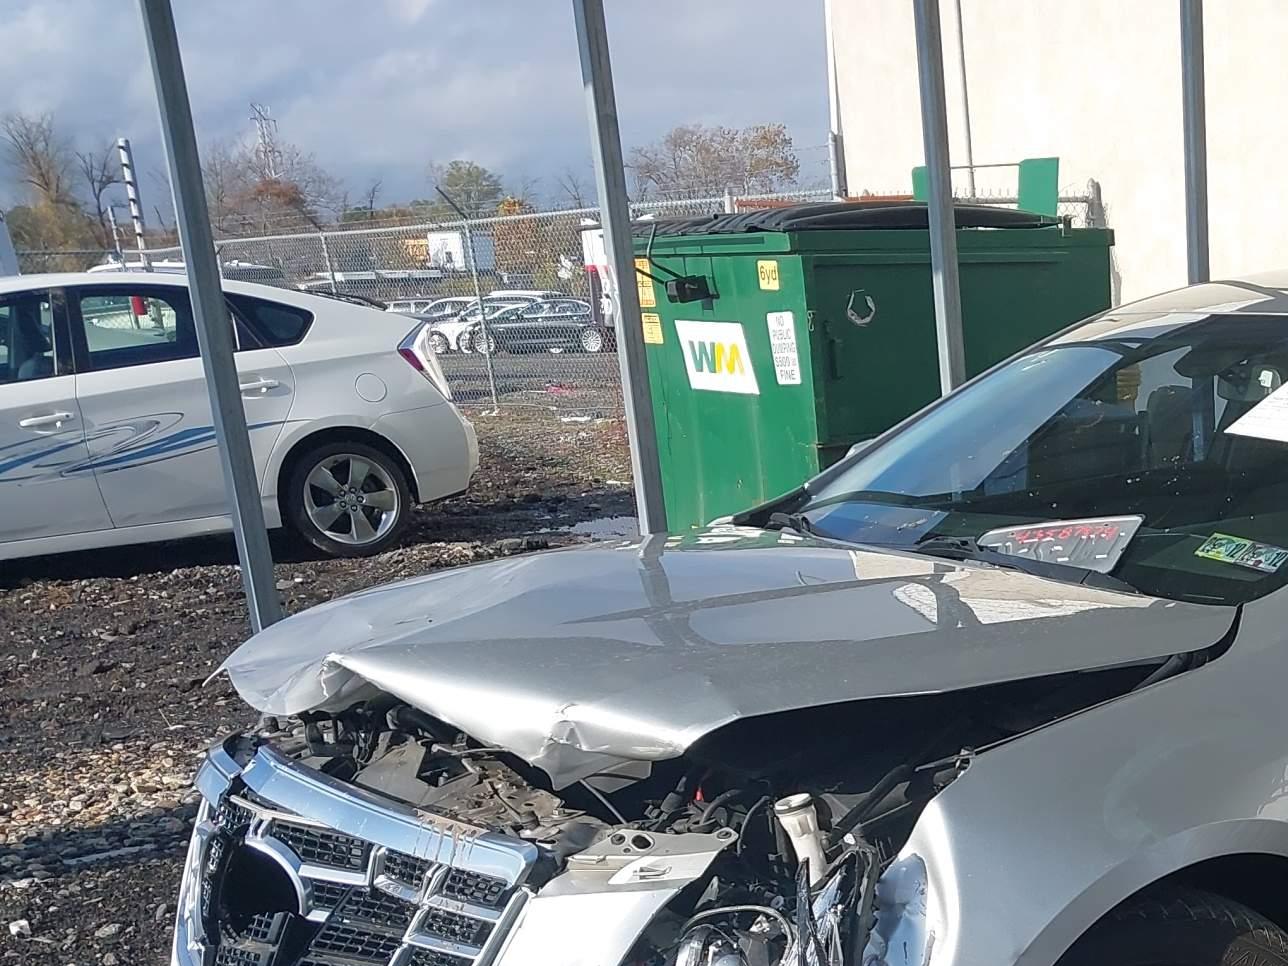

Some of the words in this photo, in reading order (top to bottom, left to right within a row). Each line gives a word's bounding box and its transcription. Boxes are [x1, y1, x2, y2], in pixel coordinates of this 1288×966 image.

[759, 264, 777, 285] 6yd
[772, 328, 791, 340] PUBLIC
[689, 340, 745, 376] WM
[780, 369, 796, 381] FINE
[1269, 552, 1288, 567] 12
